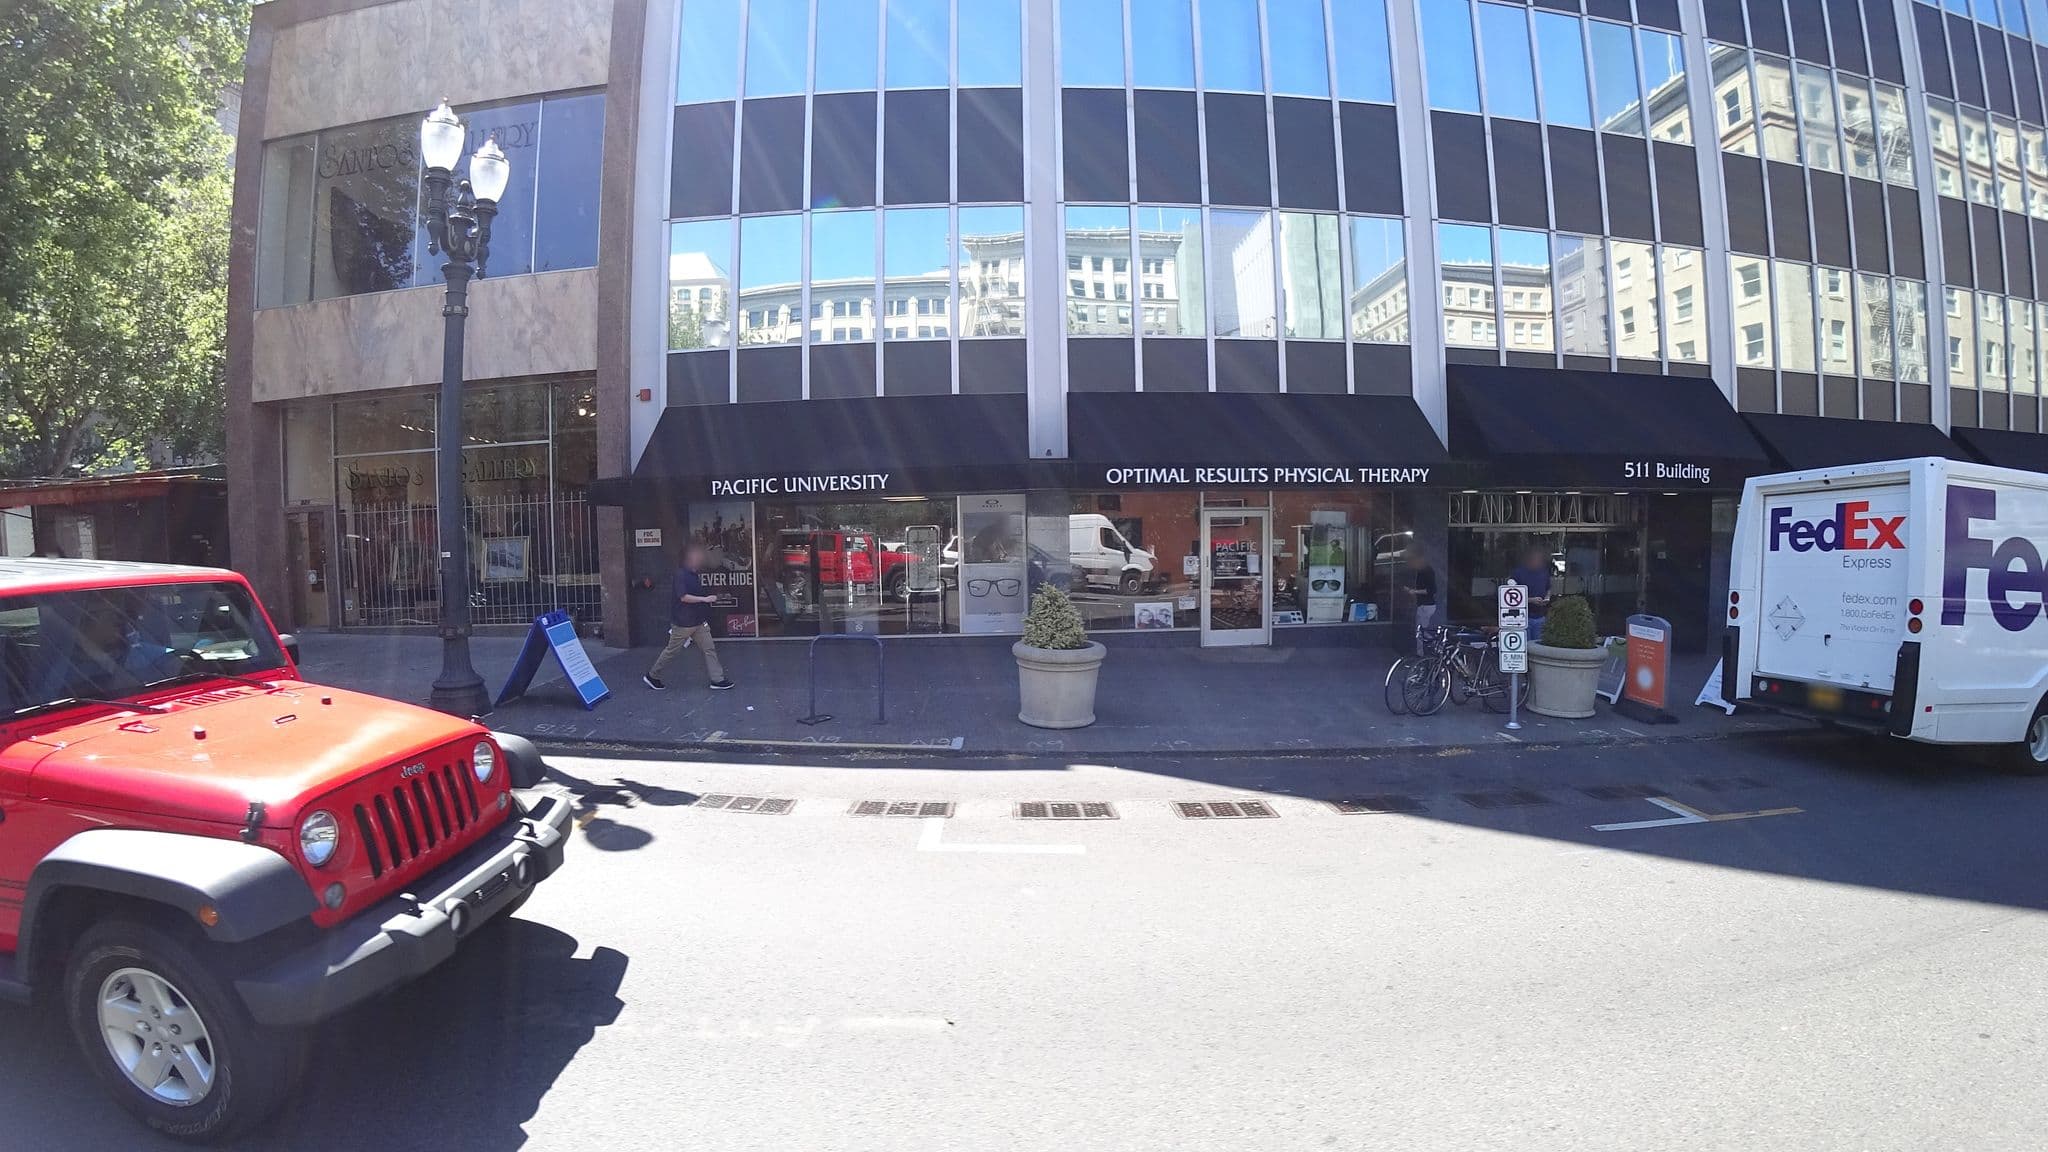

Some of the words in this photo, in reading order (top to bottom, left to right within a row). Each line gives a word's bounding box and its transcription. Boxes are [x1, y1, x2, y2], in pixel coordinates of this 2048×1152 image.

[1106, 468, 1190, 484] OPTIMAL
[1195, 467, 1269, 483] RESULTS
[1274, 467, 1354, 483] PHYSICAL
[1358, 468, 1430, 483] THERAPY
[1624, 461, 1649, 478] 511
[1656, 462, 1711, 484] Building
[711, 478, 779, 496] PACIFIC
[784, 473, 889, 493] UNIVERSITY
[1769, 500, 1907, 553] FedEx
[1842, 555, 1892, 570] Express
[1941, 484, 2048, 632] Fe
[698, 572, 727, 587] EVER
[729, 572, 753, 586] HIDE
[1842, 591, 1897, 606] fedex.com
